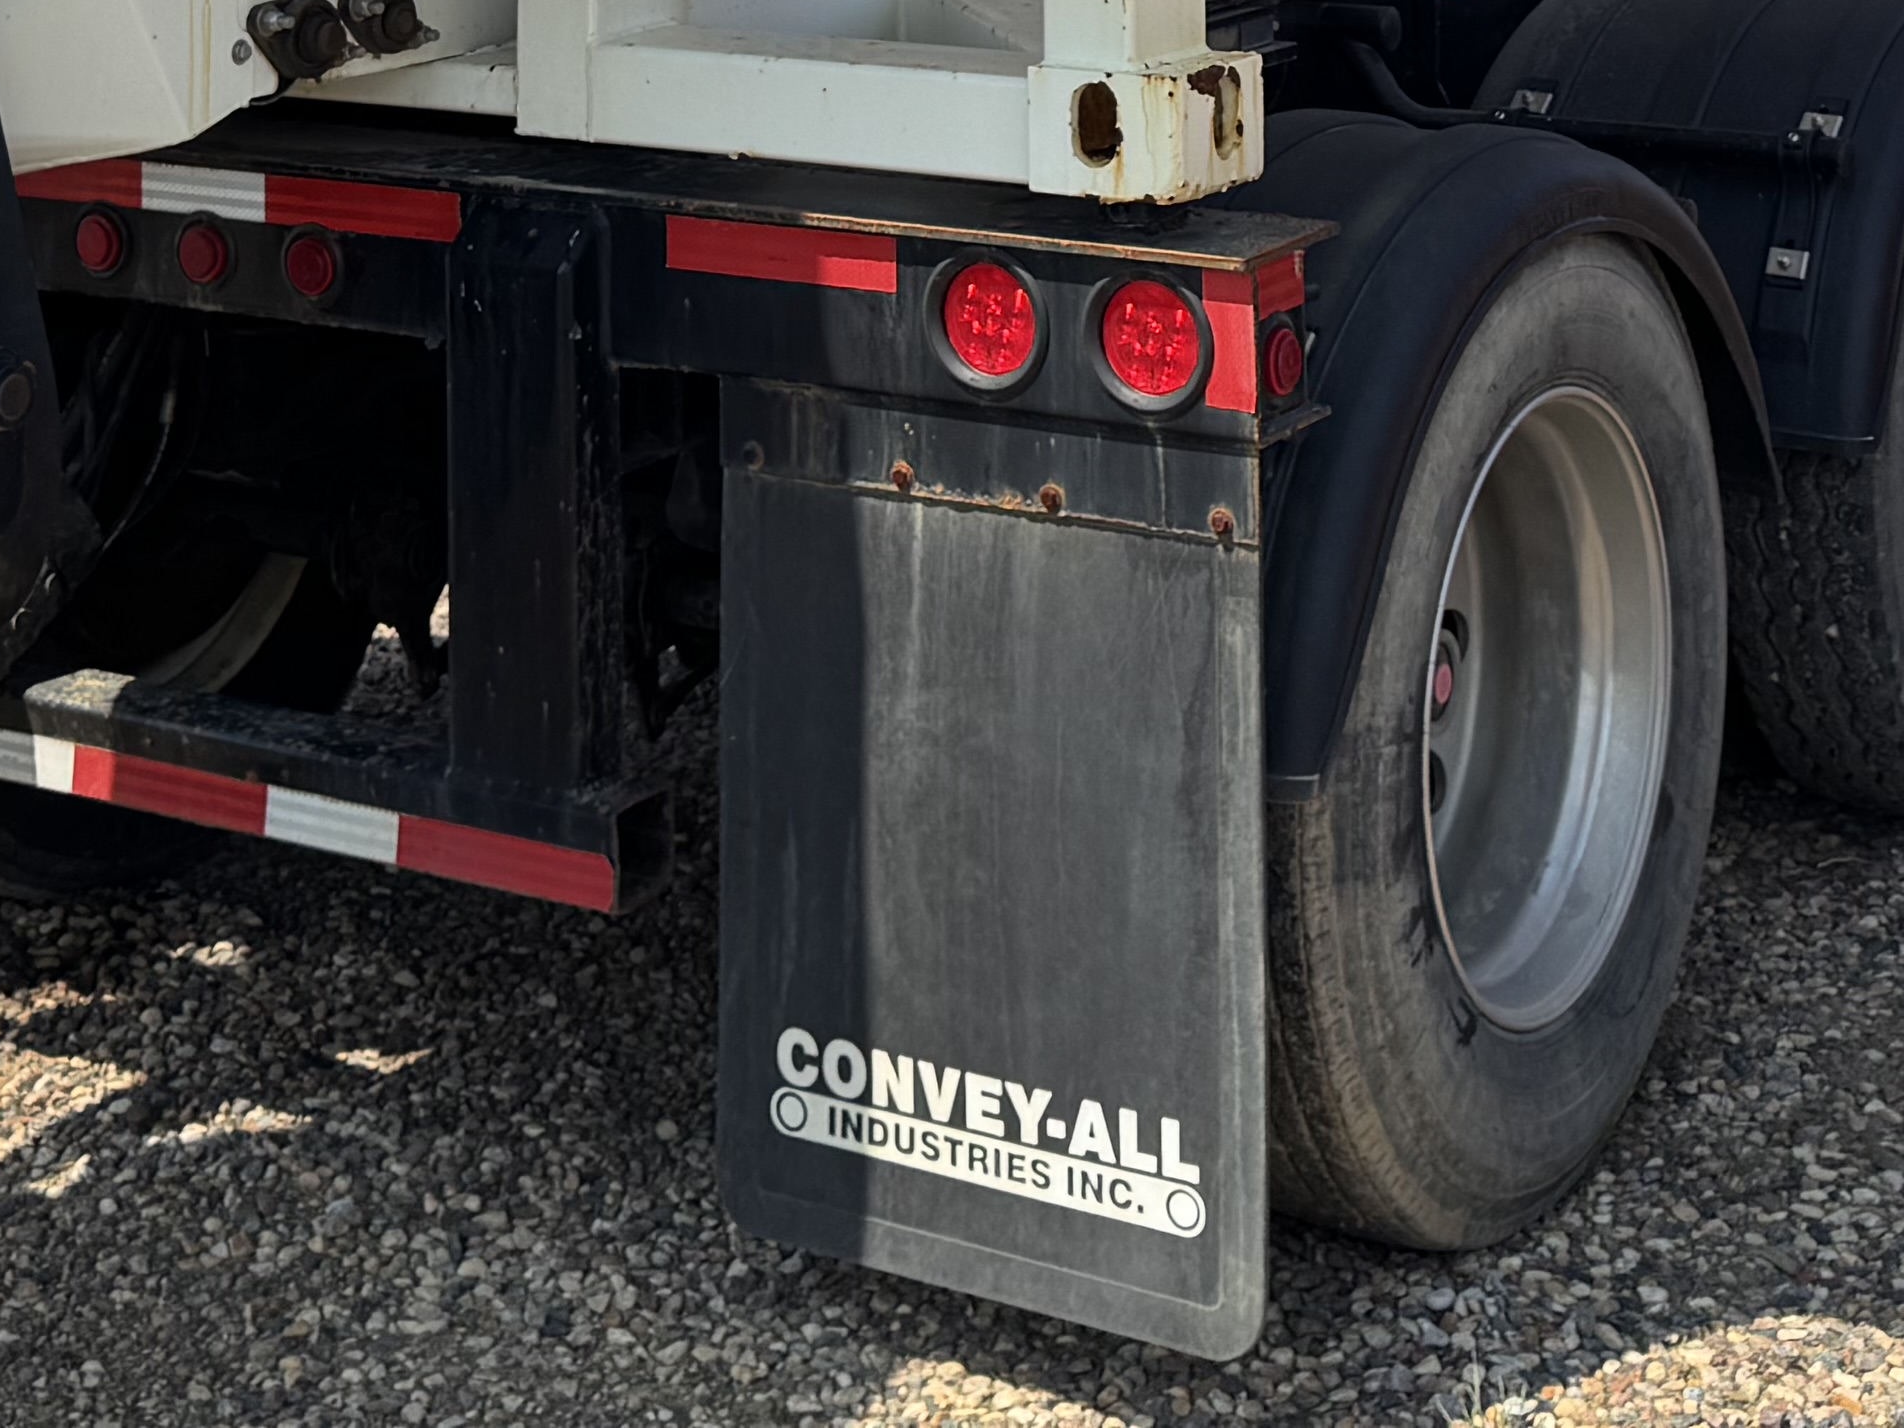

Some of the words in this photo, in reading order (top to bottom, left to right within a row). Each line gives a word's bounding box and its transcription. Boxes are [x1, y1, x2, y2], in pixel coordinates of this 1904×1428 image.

[775, 1025, 1202, 1185] CONVEY-ALL
[826, 1105, 1052, 1190] INDUSTRIES
[1066, 1166, 1146, 1215] INC.
